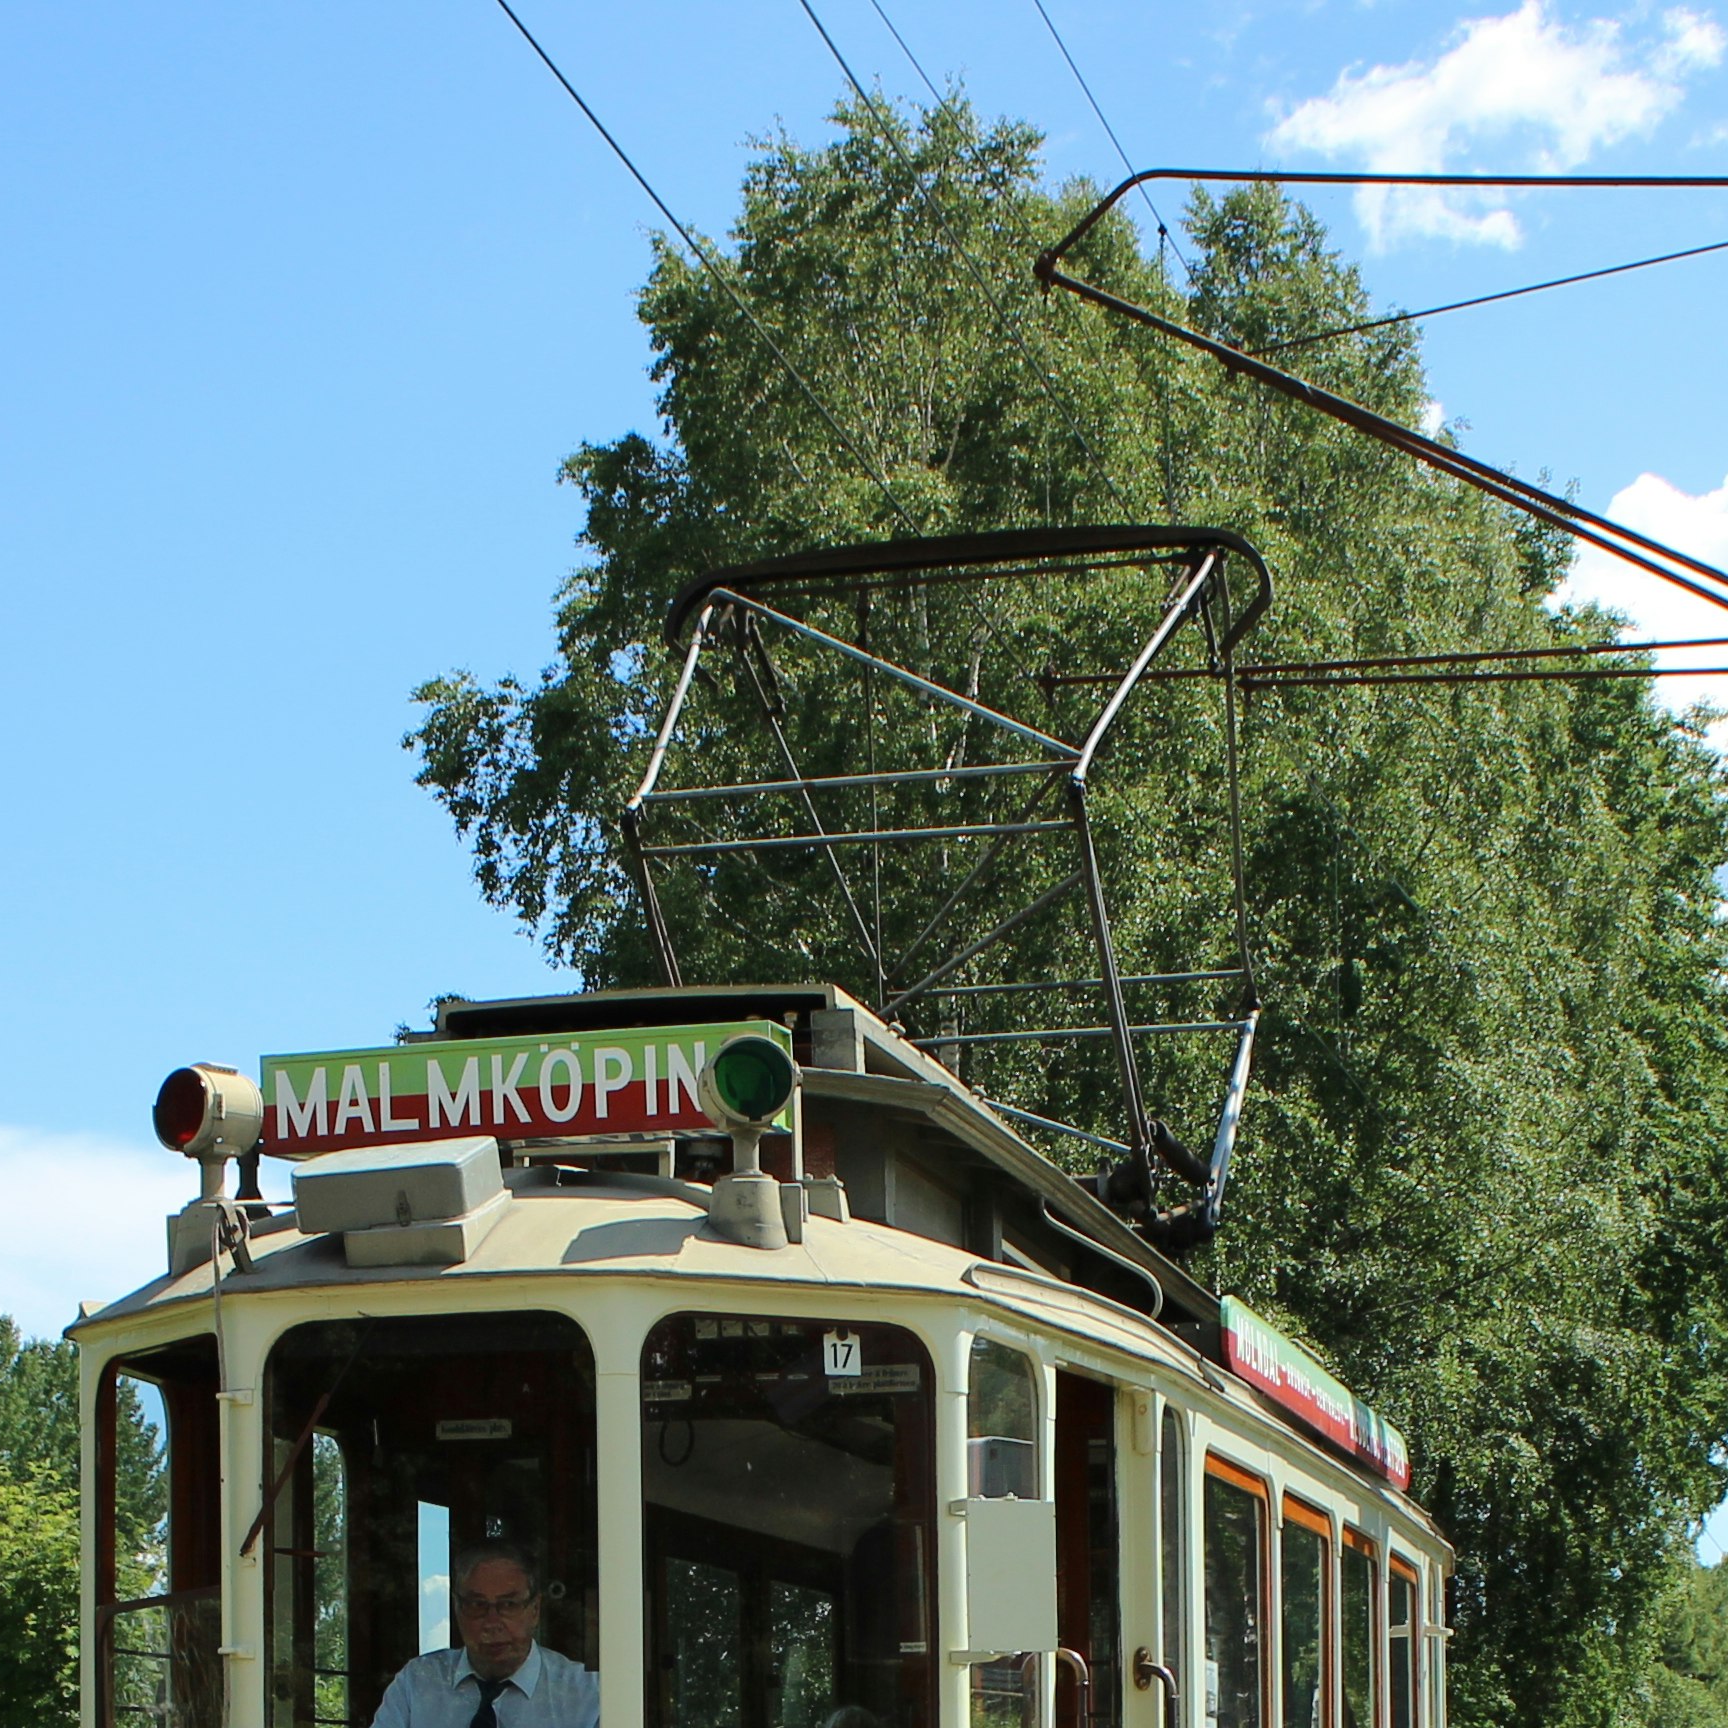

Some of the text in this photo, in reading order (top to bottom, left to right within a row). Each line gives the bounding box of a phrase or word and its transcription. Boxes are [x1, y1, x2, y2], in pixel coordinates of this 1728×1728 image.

[275, 1041, 708, 1140] MALMKÖPIN
[830, 1342, 853, 1369] 17
[1236, 1314, 1281, 1387] MÖLNDAL
